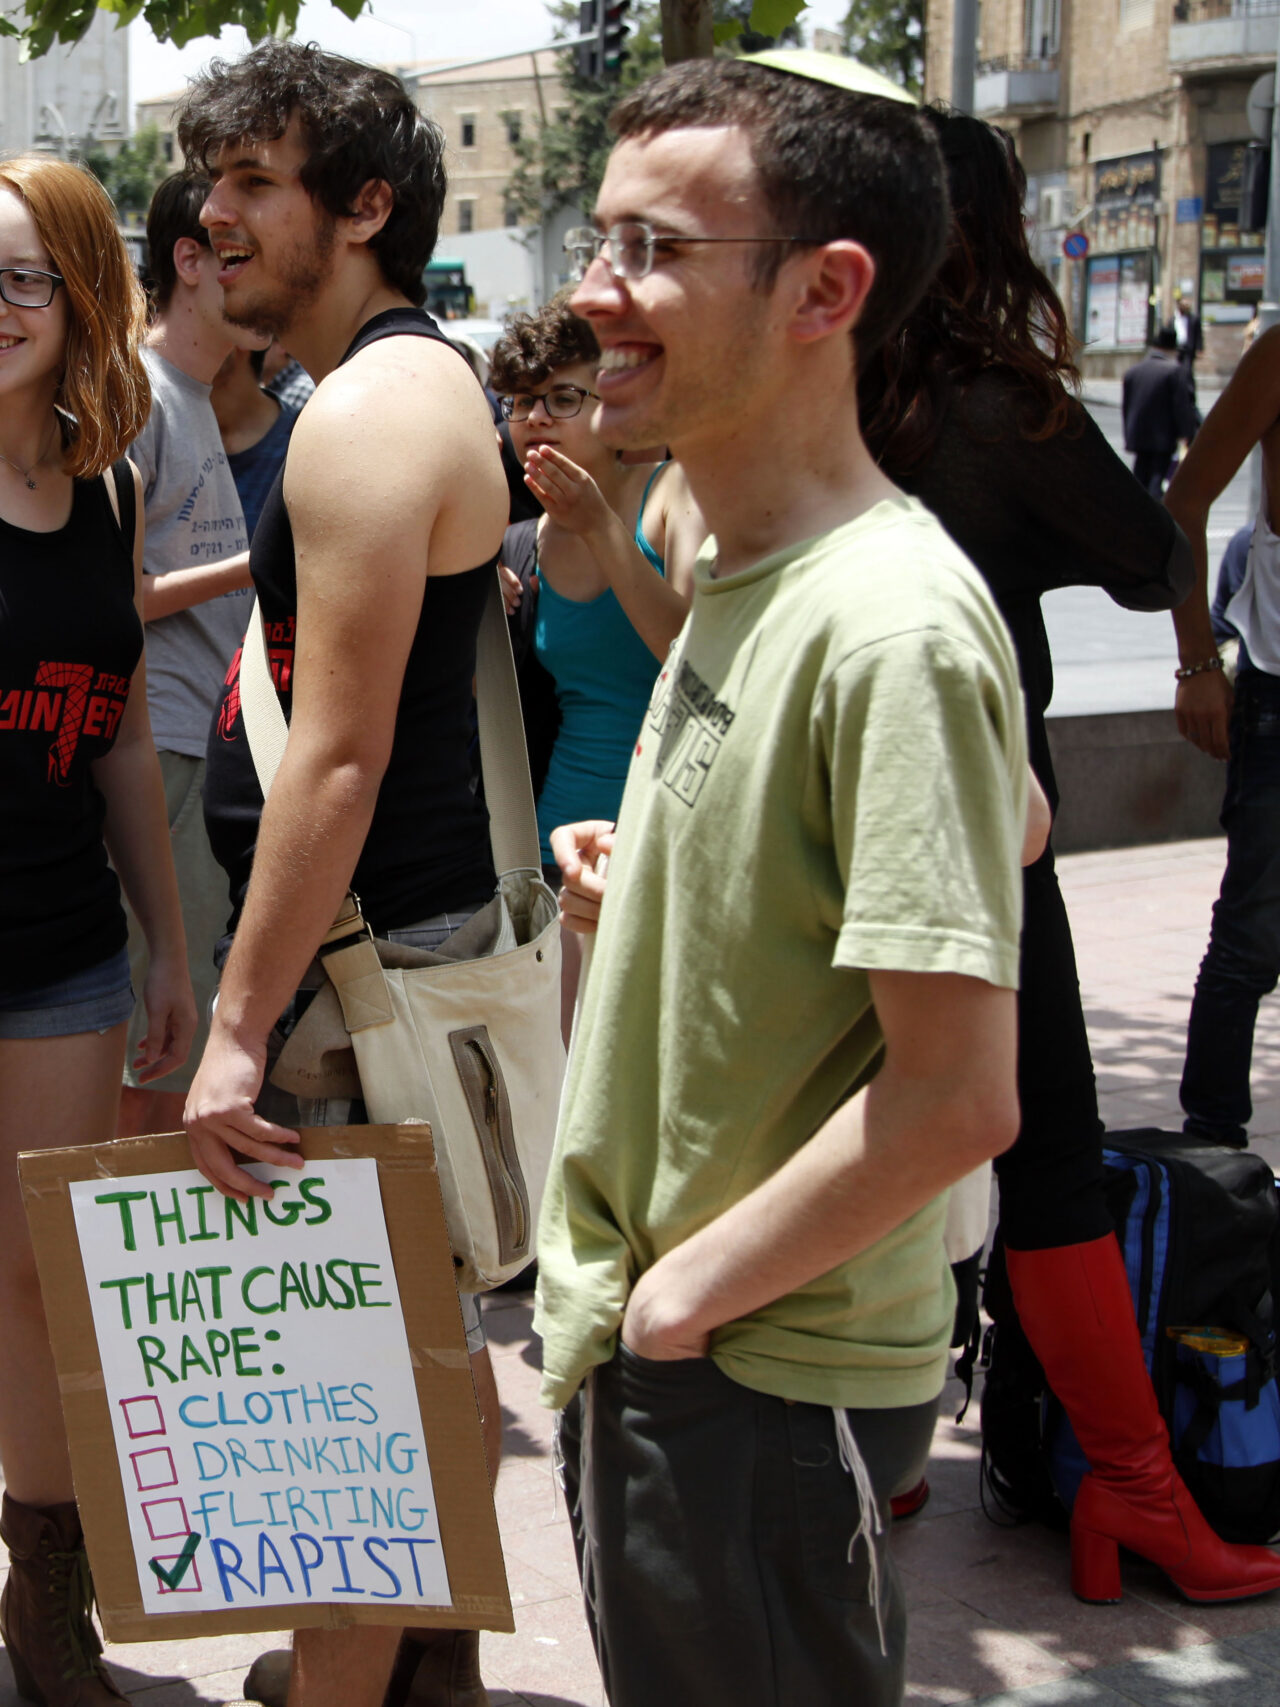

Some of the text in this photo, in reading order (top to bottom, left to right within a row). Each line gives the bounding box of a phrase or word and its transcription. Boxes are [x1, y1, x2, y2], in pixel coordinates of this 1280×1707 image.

[94, 1177, 333, 1251] THINGS
[99, 1258, 393, 1330] THAT CAUSE
[136, 1327, 286, 1387] RAPE:
[178, 1381, 379, 1429] CLOTHES
[193, 1431, 419, 1481] DRINKING
[191, 1486, 429, 1537] FLIRTING
[210, 1531, 436, 1602] RAPIST
